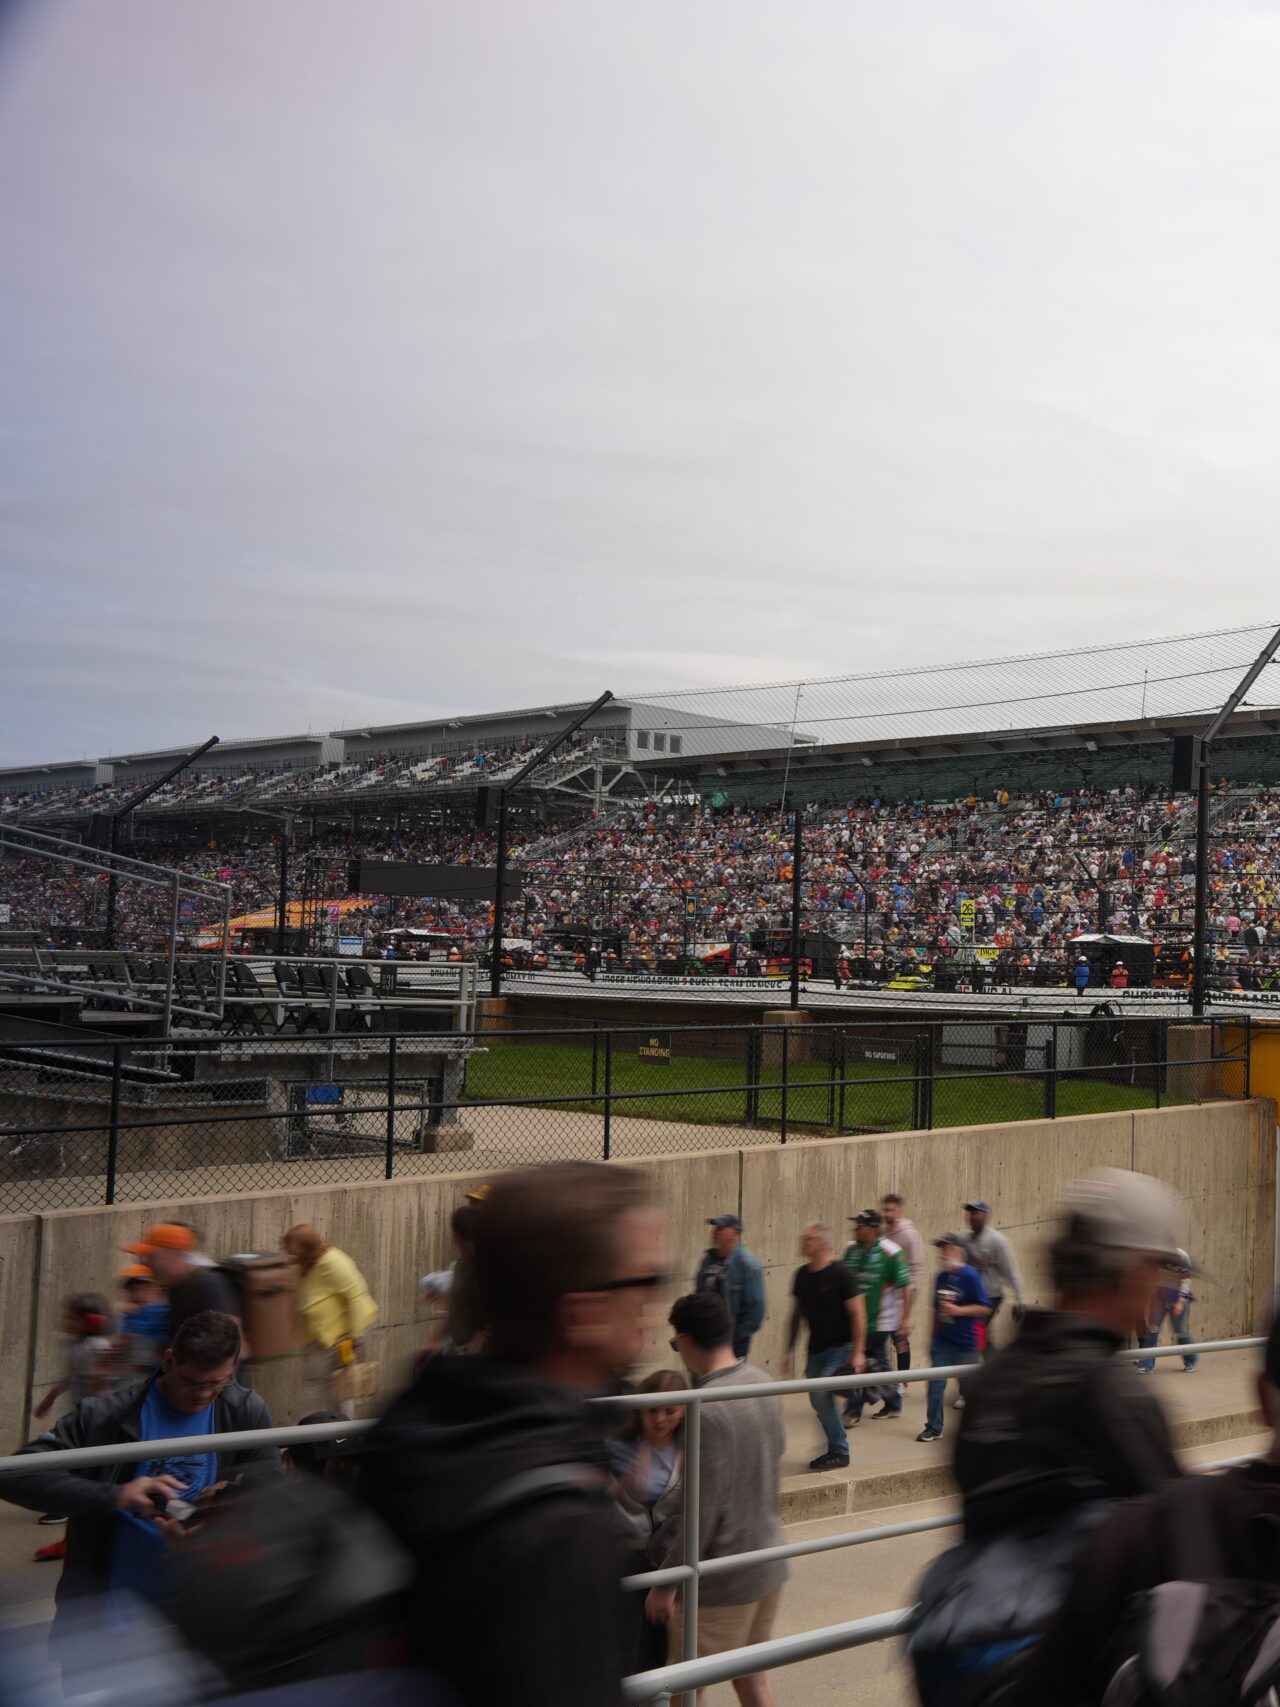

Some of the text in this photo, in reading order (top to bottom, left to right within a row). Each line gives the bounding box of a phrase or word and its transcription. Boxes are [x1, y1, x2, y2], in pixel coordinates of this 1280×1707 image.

[962, 903, 973, 915] 26
[650, 1038, 659, 1046] NO
[640, 1047, 671, 1057] STANDING
